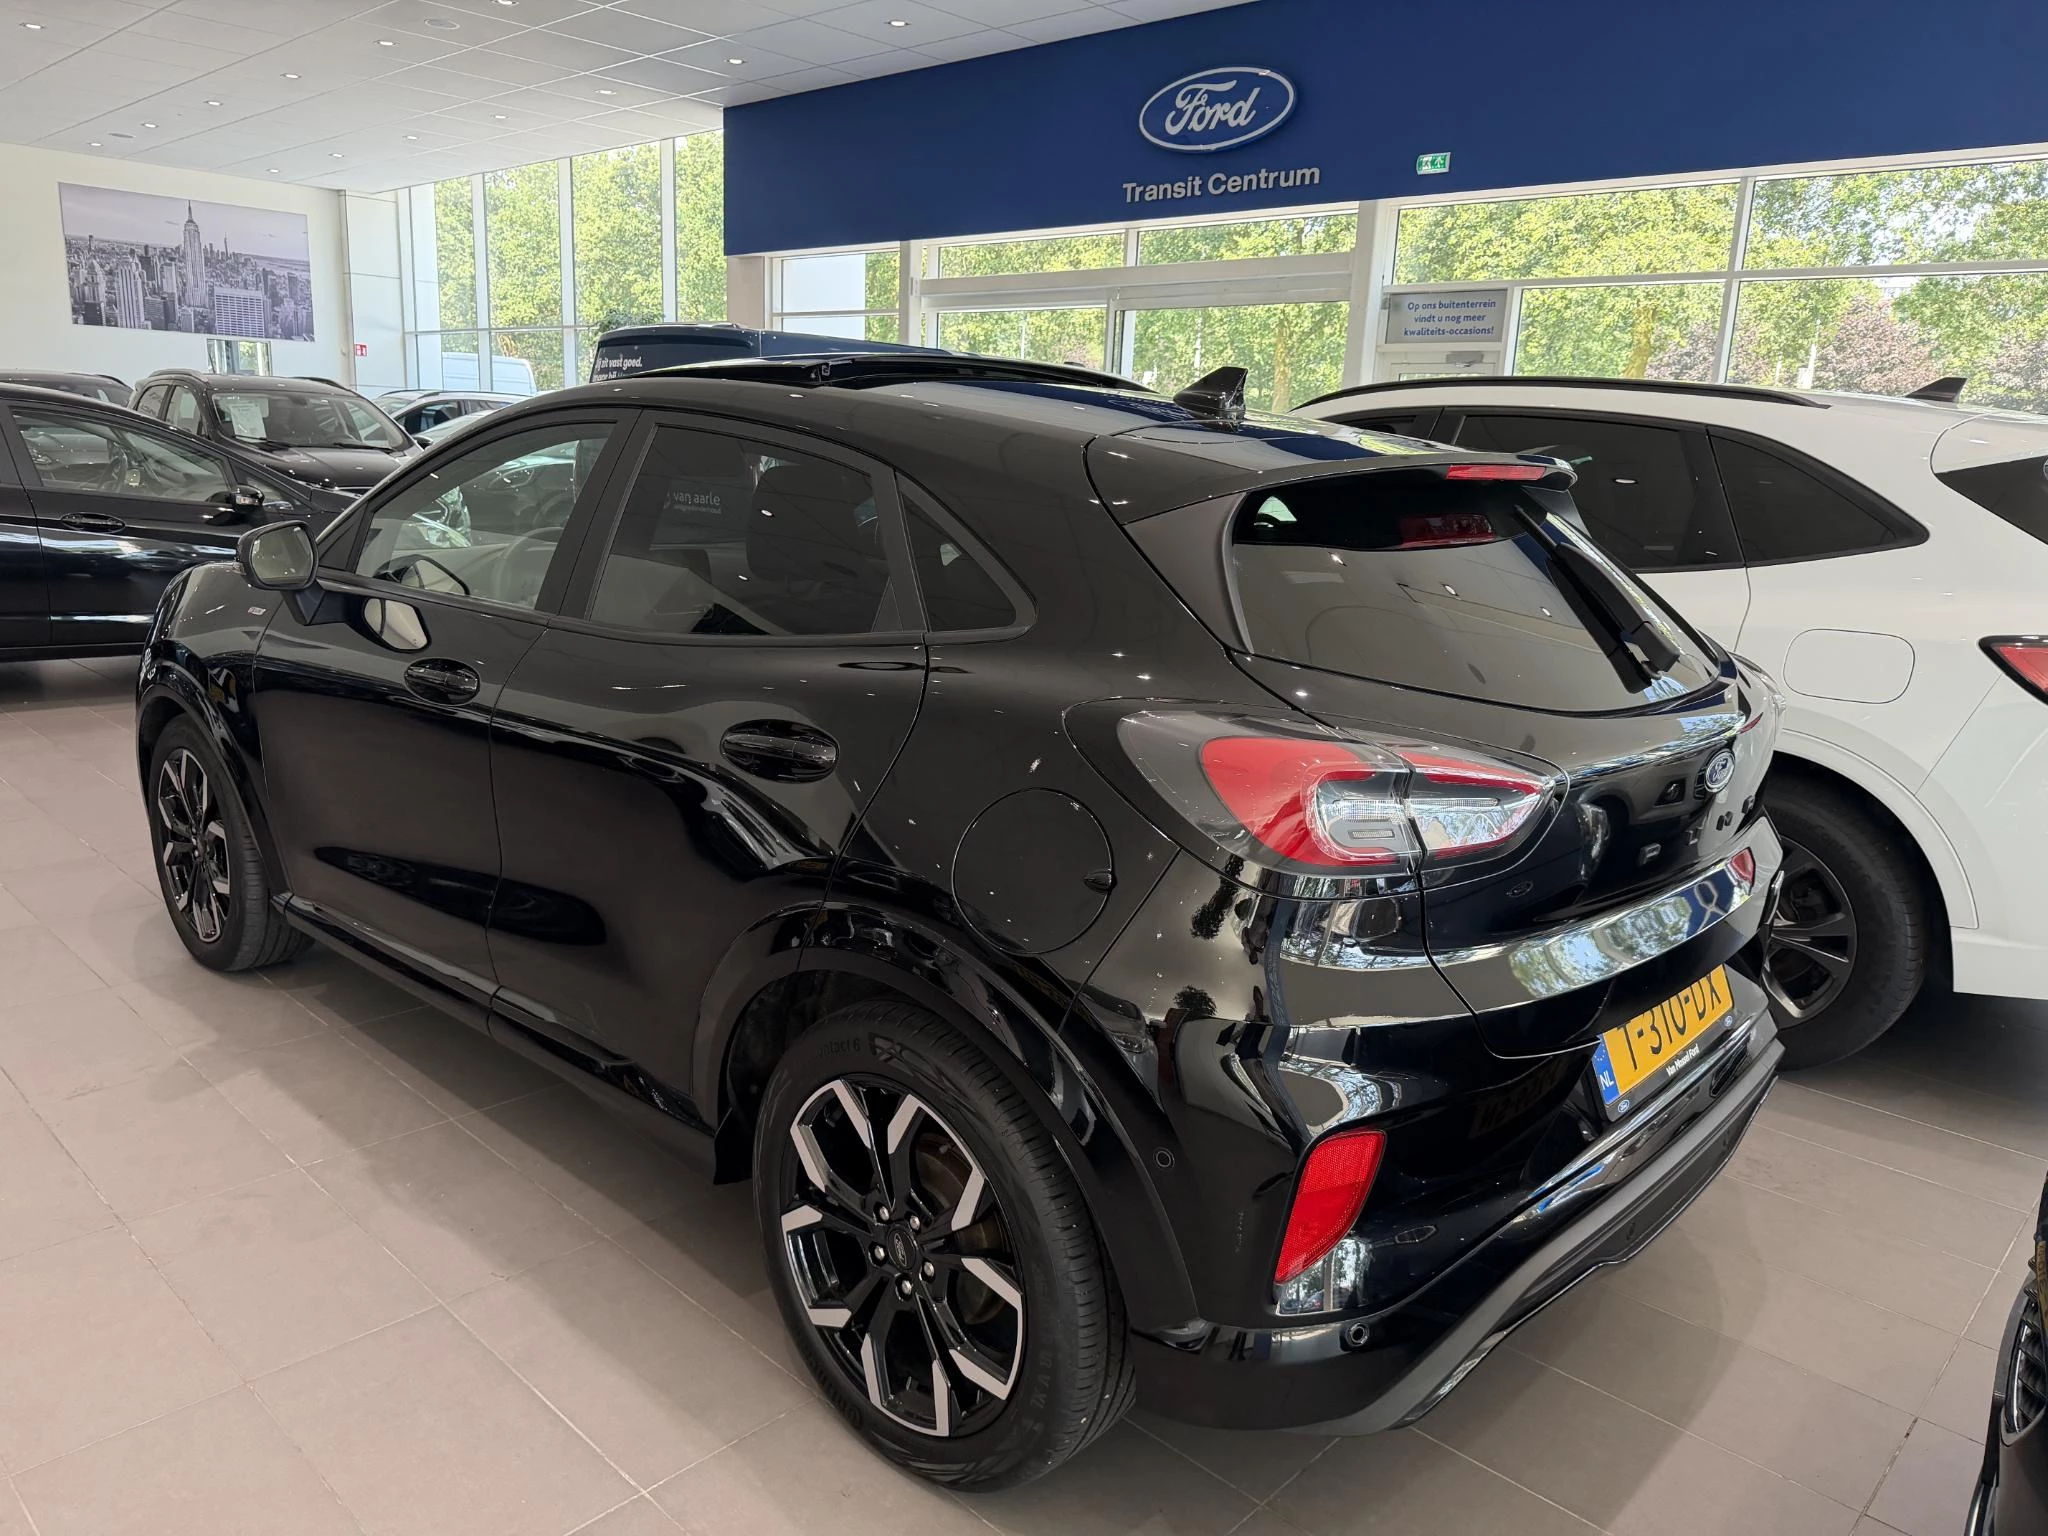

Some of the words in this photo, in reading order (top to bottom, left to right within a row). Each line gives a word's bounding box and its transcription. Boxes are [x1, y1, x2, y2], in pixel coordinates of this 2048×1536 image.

[1165, 79, 1260, 135] Ford
[1122, 175, 1202, 203] Transit
[1207, 166, 1320, 195] Centrum
[1407, 301, 1420, 312] Op
[1421, 302, 1437, 310] ons
[1438, 299, 1497, 310] buitenterrein
[1414, 313, 1436, 323] vindt
[1444, 315, 1461, 325] nog
[1463, 313, 1486, 322] meer
[1403, 326, 1495, 337] kwaliteits-occasions!
[609, 357, 623, 368] vast
[1665, 1064, 1677, 1077] Van
[1674, 1050, 1691, 1070] Mossel
[1688, 1043, 1700, 1059] Ford
[1600, 1070, 1614, 1090] NL
